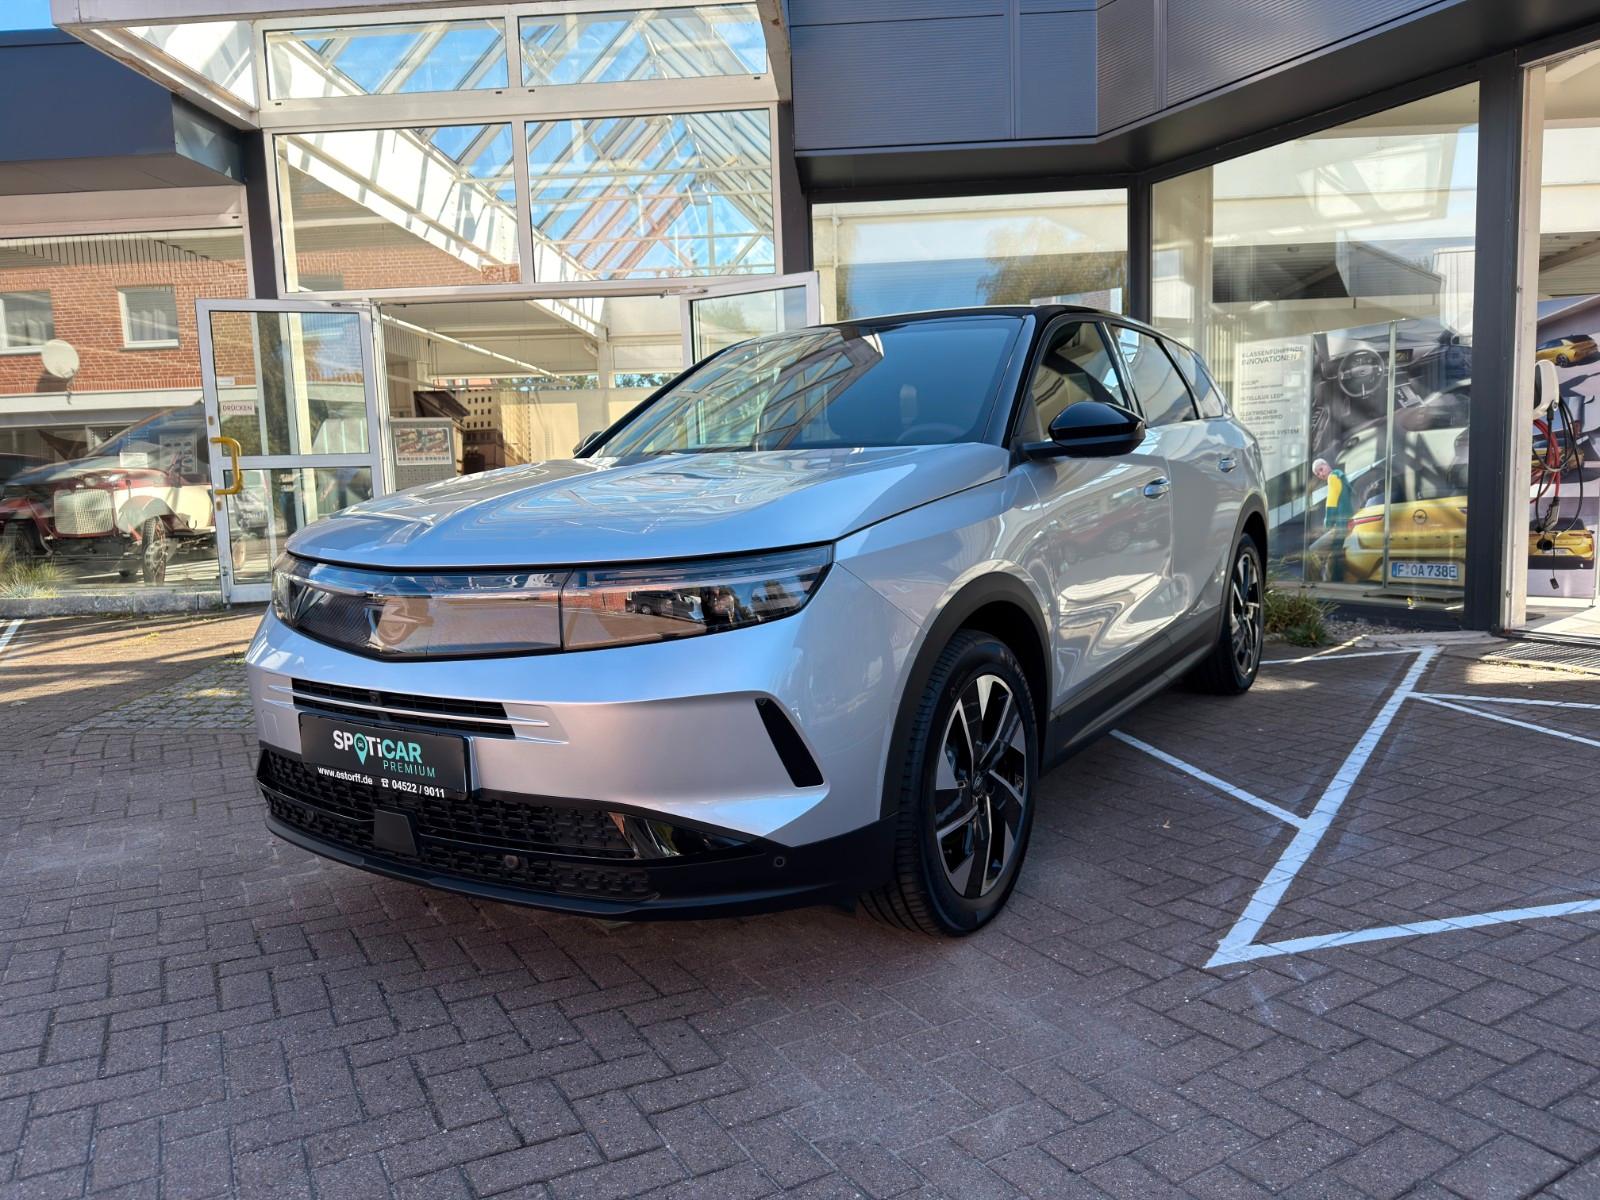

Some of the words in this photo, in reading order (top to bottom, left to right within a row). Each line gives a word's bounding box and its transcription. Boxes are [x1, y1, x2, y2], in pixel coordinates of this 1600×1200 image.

[1241, 354, 1297, 366] INNOVATIONEN
[222, 404, 253, 412] DRÜCKEN
[382, 759, 436, 778] PREMIUM
[317, 766, 373, 785] www.estorff.de
[391, 780, 418, 794] 04522
[424, 786, 445, 799] 9011
